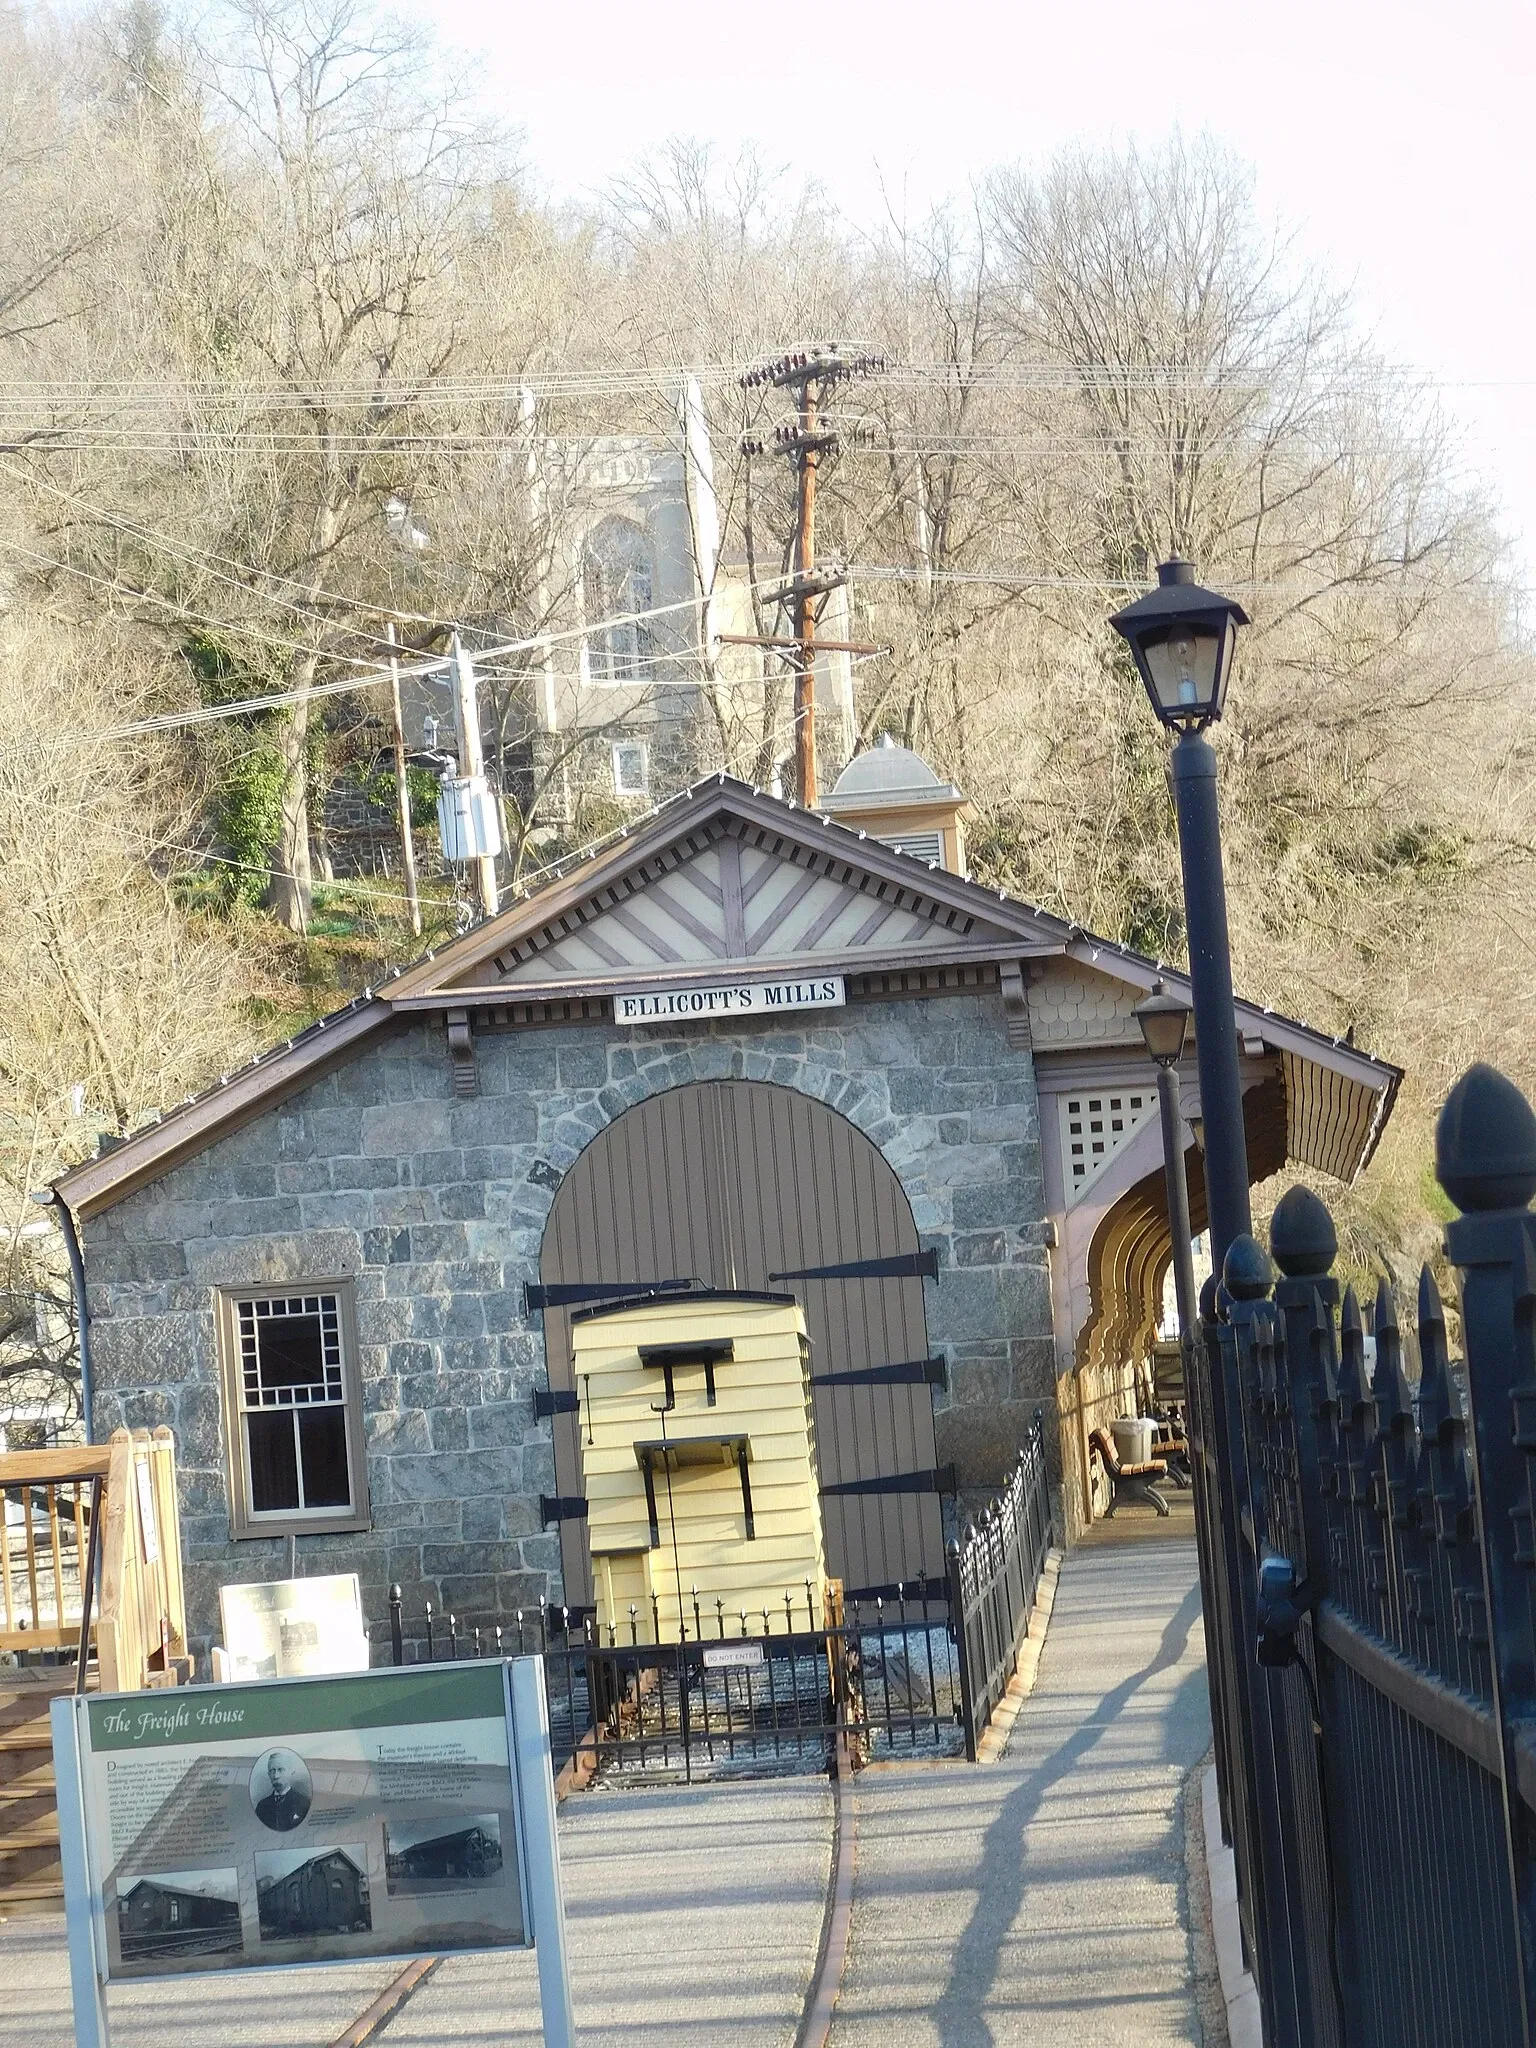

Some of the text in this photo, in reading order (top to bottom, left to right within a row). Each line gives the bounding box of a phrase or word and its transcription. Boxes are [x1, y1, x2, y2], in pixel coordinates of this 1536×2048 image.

[622, 981, 836, 1017] ELLICOTT'S MILLS
[735, 1652, 759, 1660] ENTER
[103, 1701, 245, 1739] The Freight House
